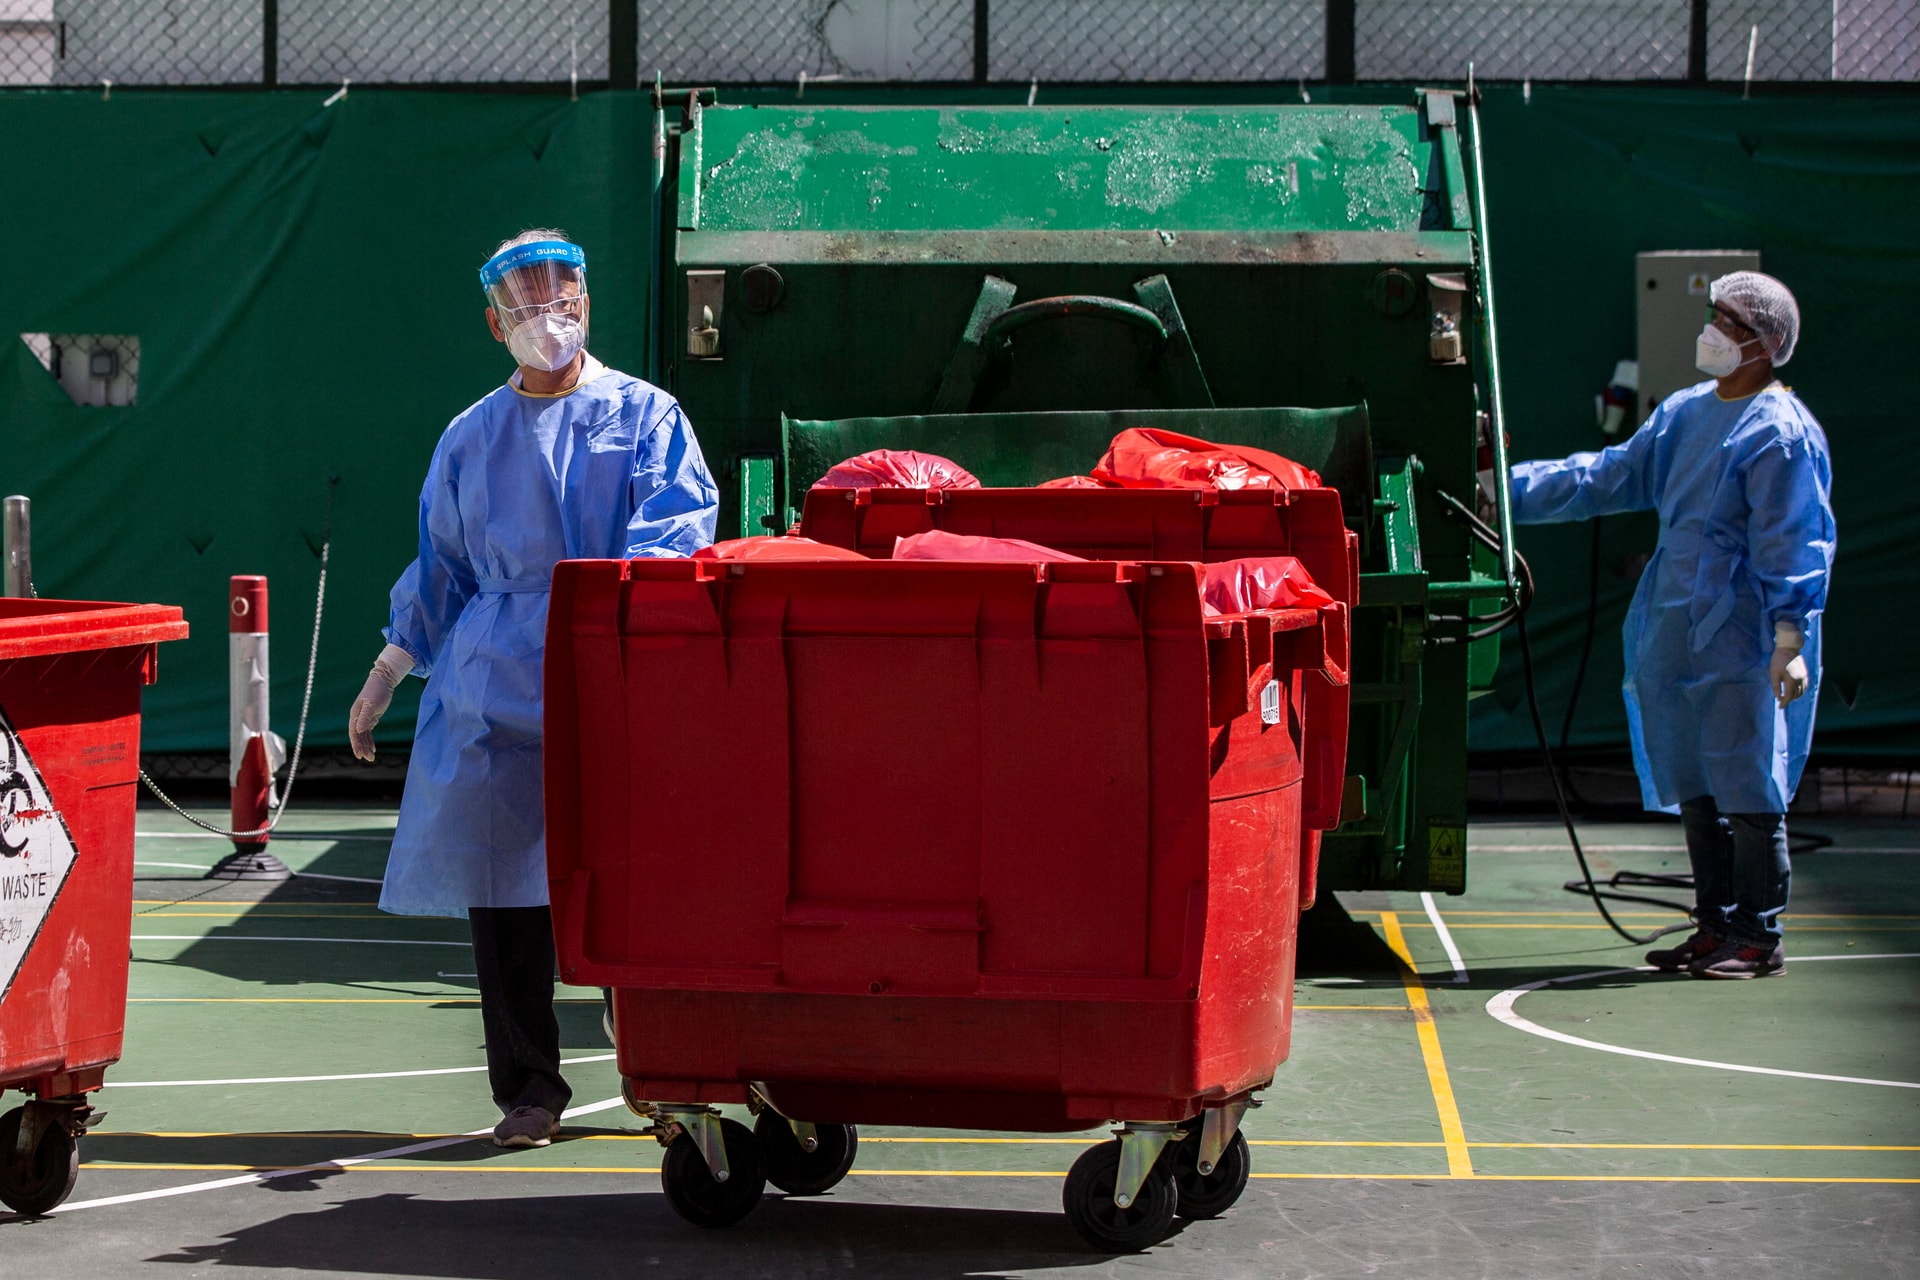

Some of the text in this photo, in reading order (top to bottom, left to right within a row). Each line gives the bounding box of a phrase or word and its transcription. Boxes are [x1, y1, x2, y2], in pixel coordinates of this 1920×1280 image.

[497, 251, 531, 271] SPLASH
[536, 248, 568, 256] GUARD
[2, 872, 47, 901] WASTE
